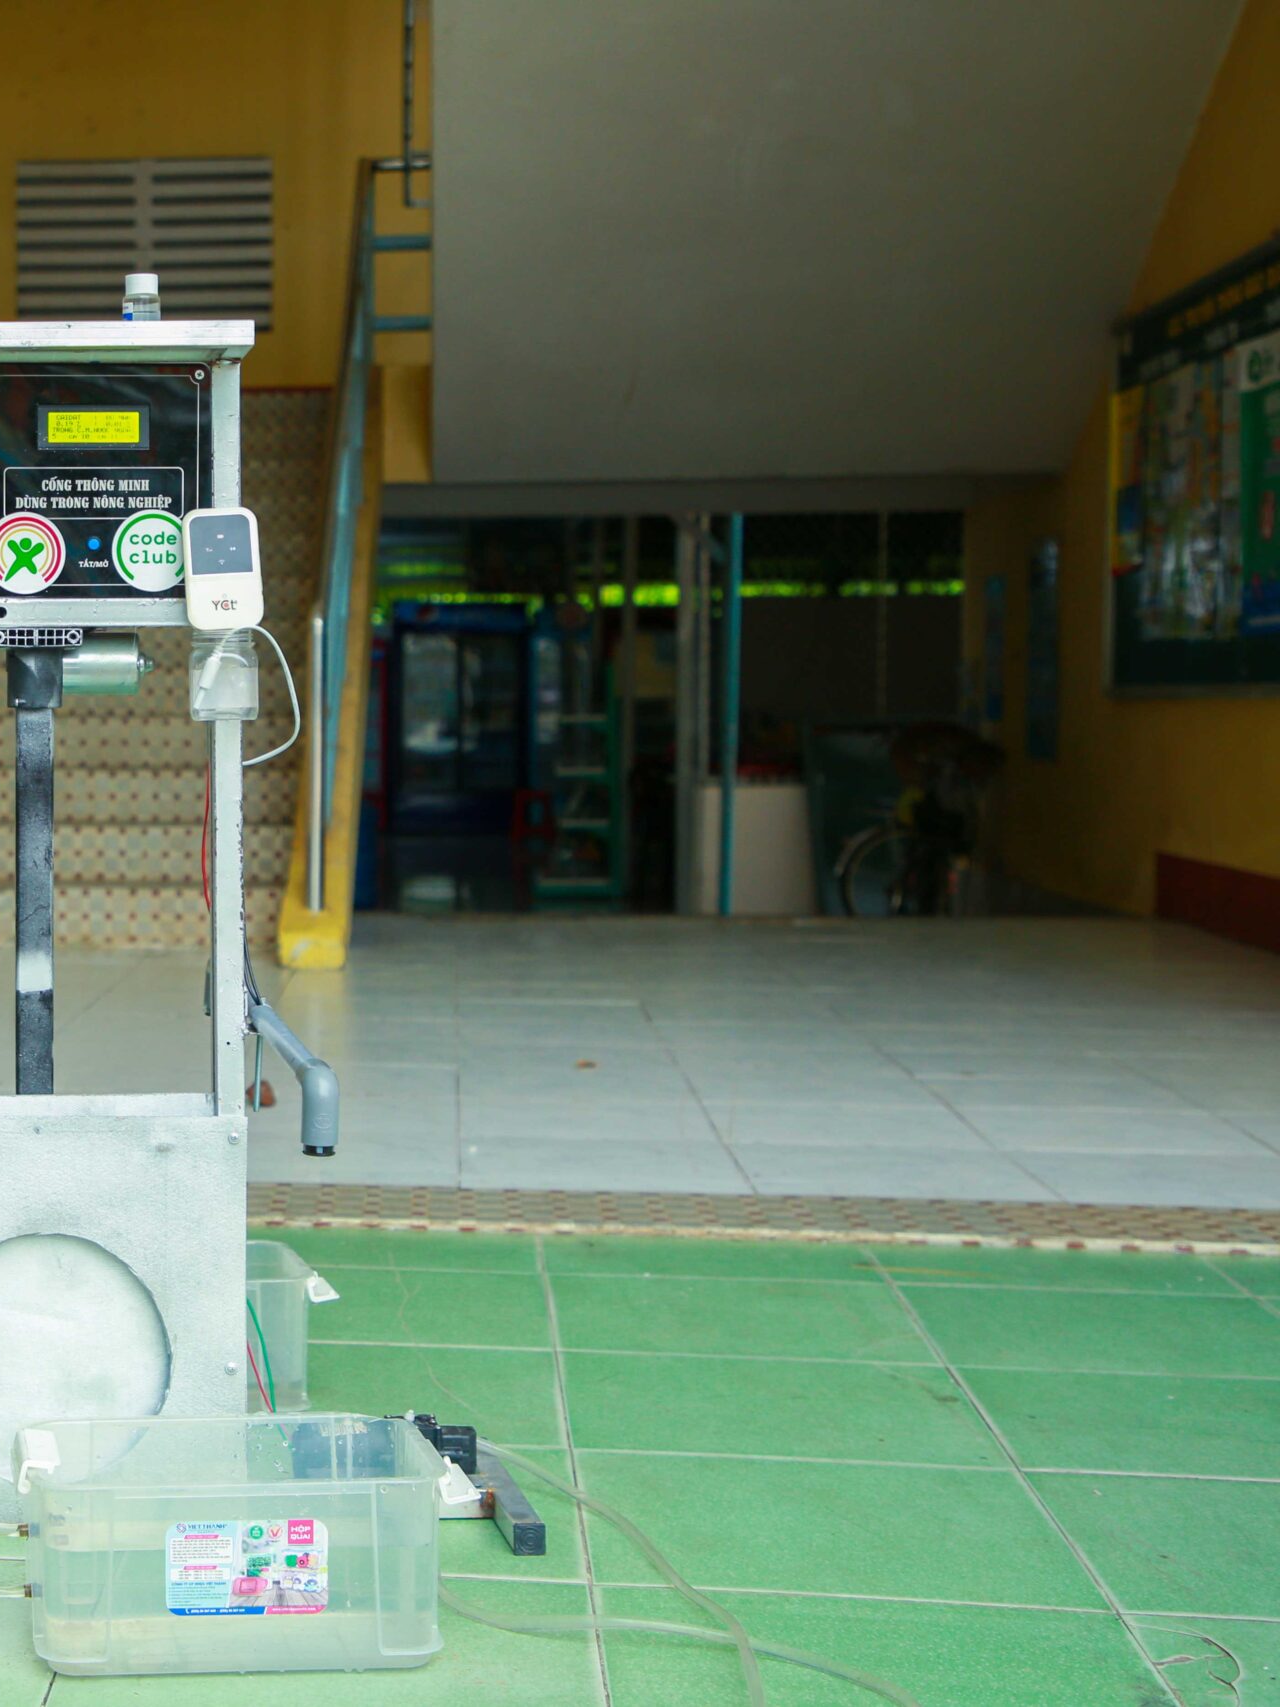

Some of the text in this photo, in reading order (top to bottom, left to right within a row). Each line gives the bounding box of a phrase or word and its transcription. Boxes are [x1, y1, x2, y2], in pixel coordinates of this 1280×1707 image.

[41, 476, 150, 492] CỐNG THÔNG MINH
[15, 494, 172, 510] DÙNG TRONG NÔNG NGHIỆP
[129, 531, 177, 545] code
[129, 550, 177, 564] club
